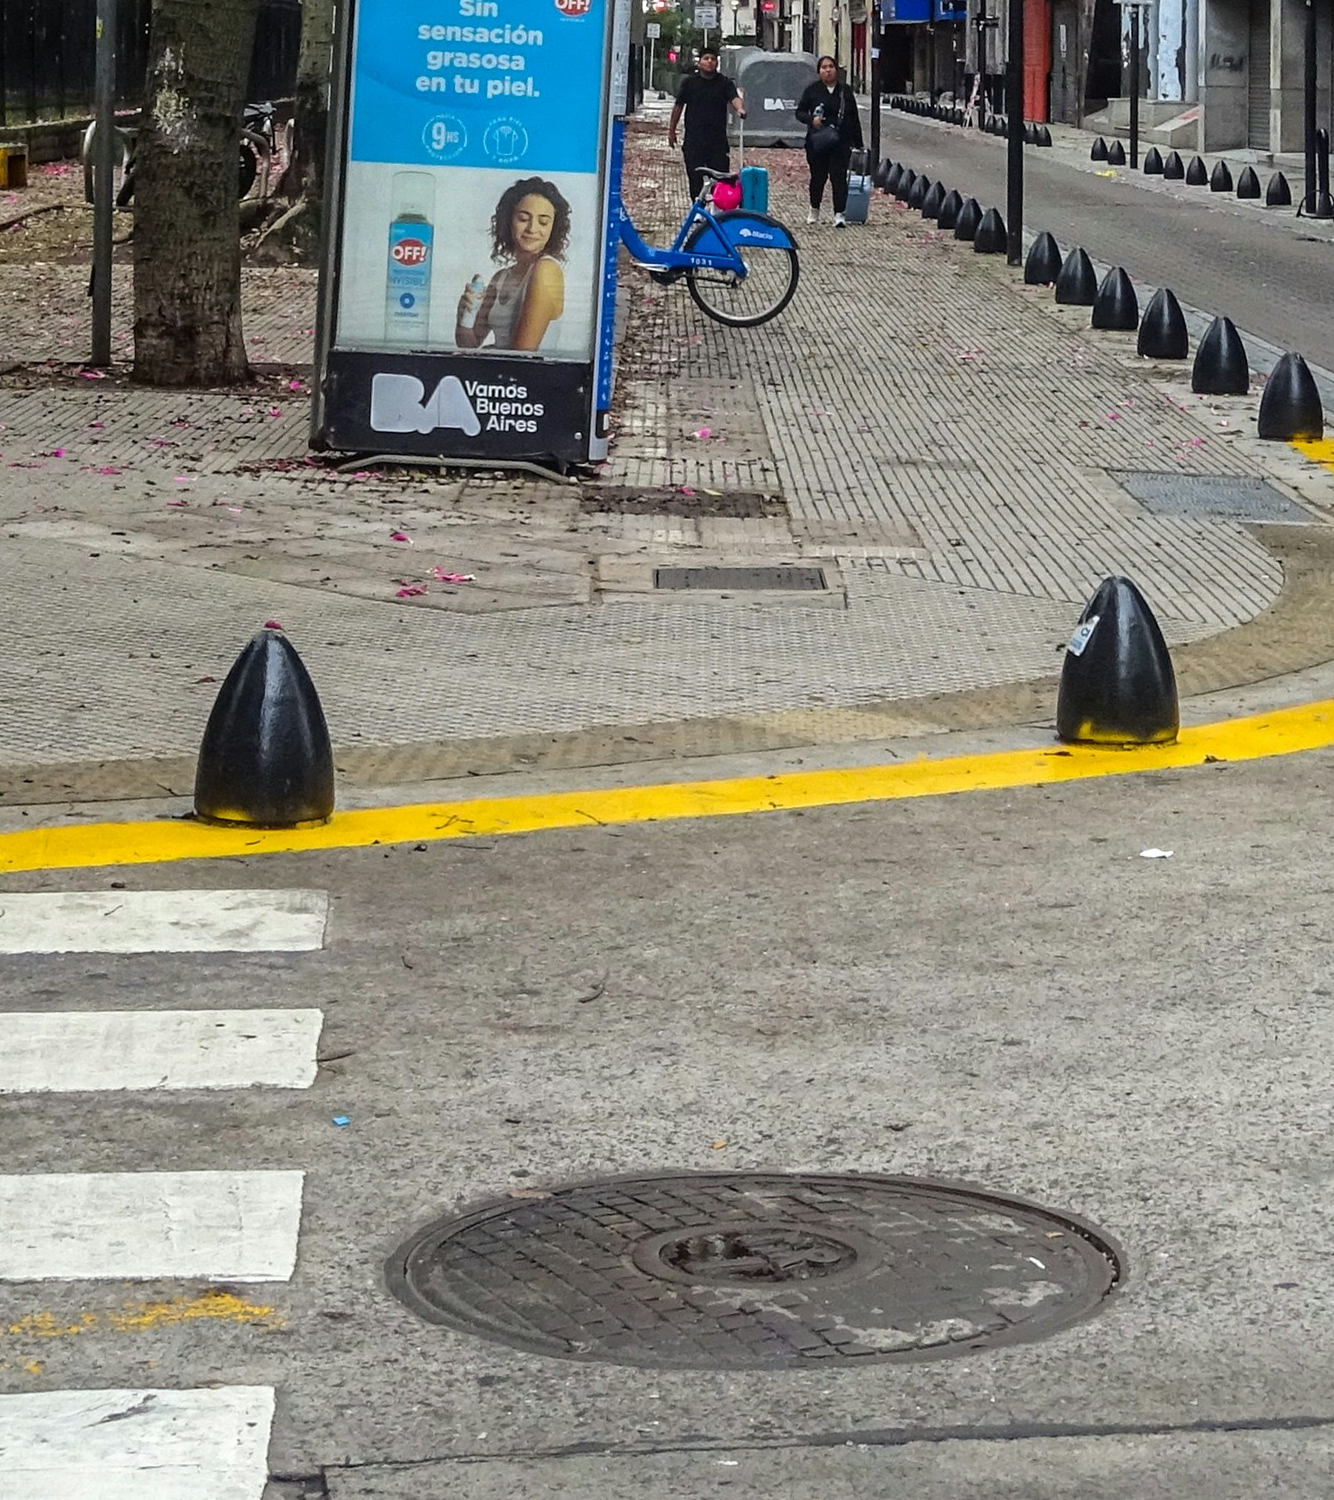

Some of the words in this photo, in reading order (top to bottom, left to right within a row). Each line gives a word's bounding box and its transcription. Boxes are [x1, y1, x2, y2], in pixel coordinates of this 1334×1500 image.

[418, 24, 543, 45] sensación
[427, 51, 525, 70] grasosa
[416, 76, 446, 92] en
[453, 74, 479, 94] tu
[487, 76, 540, 98] piel.
[392, 245, 427, 261] OFF!
[465, 380, 528, 398] Vamos
[370, 373, 482, 437] BA
[476, 398, 544, 416] Buenos
[486, 416, 538, 433] Aires
